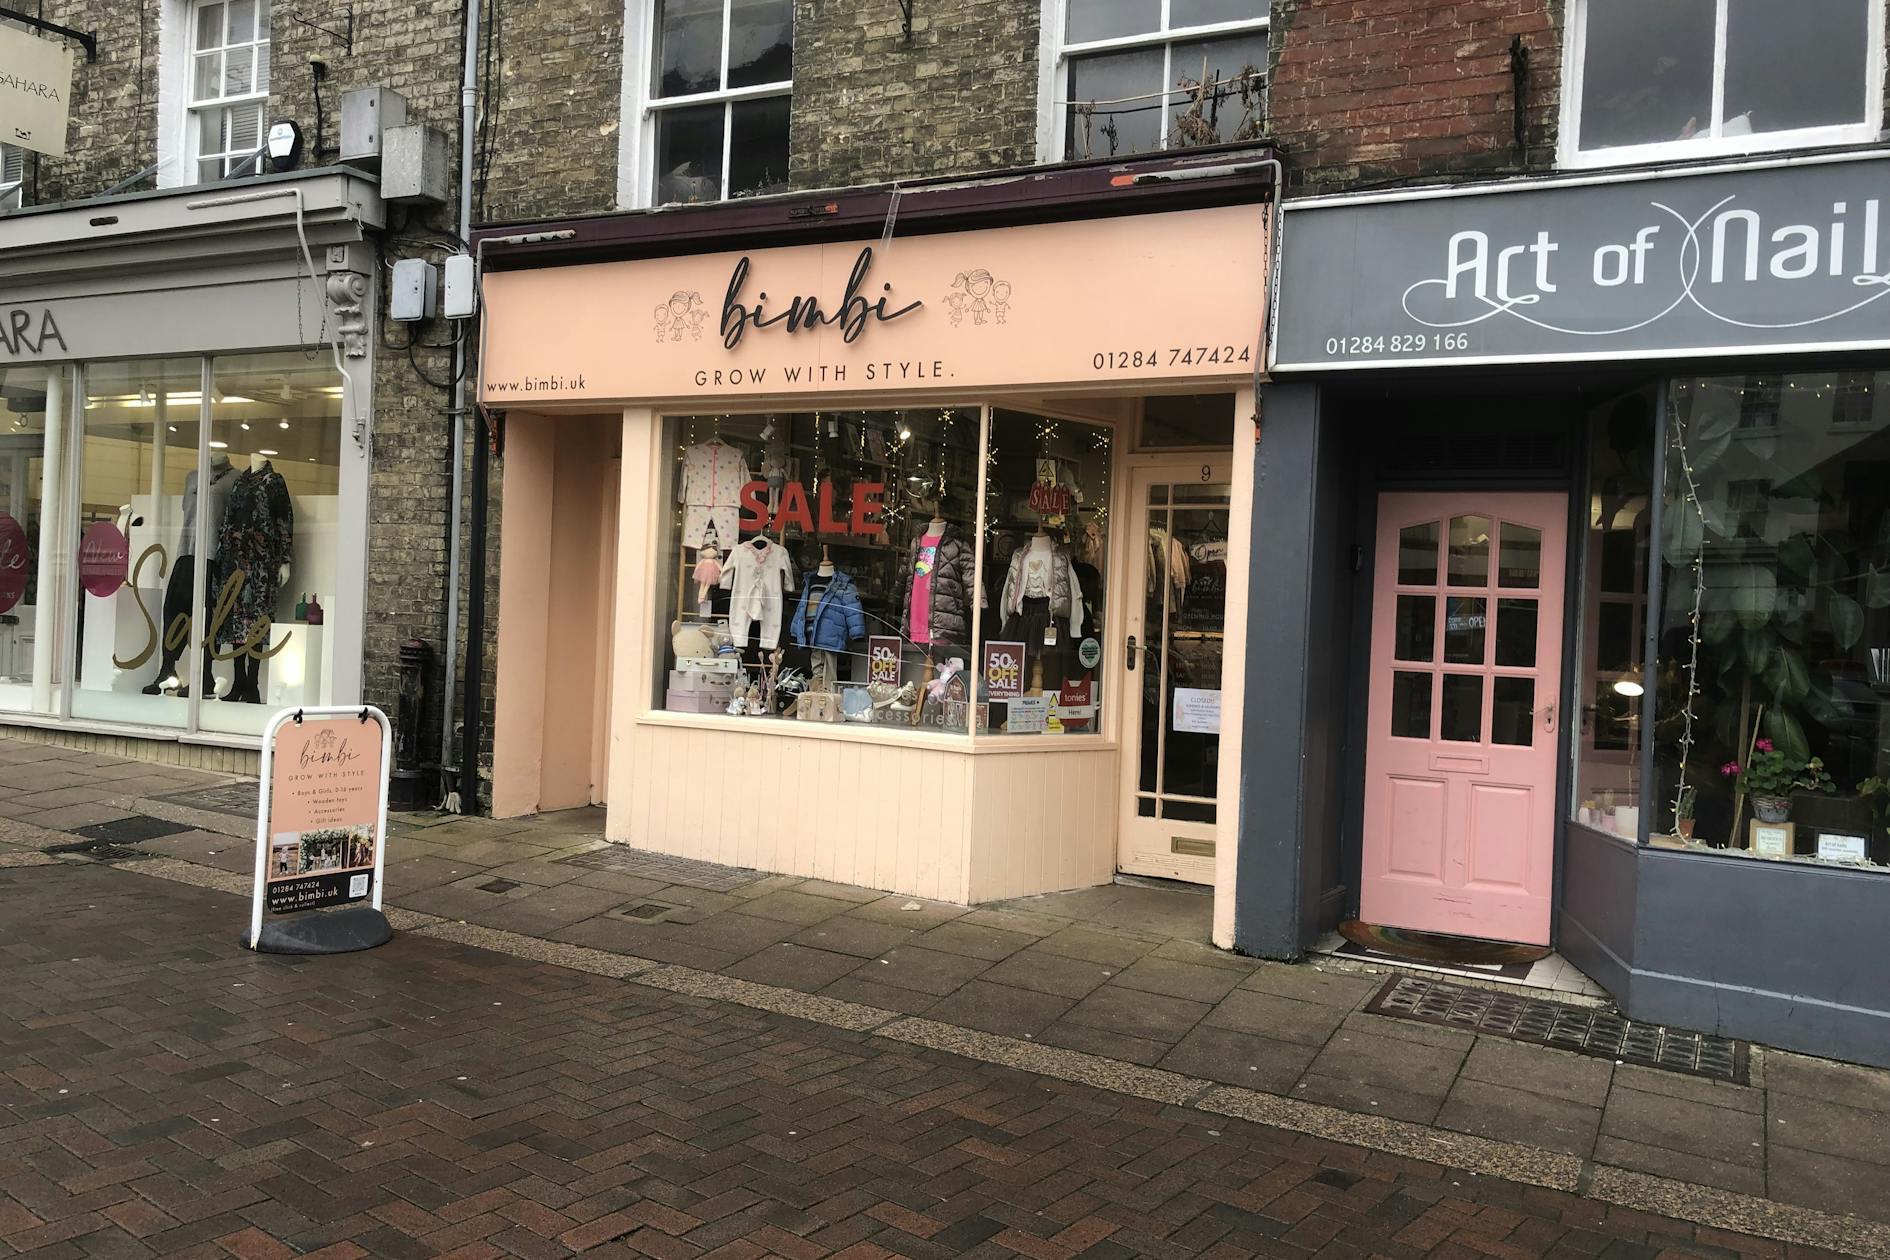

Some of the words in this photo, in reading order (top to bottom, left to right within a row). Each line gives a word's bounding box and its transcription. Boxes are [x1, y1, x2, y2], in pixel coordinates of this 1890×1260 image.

[1445, 229, 1559, 302] Art
[1592, 224, 1661, 287] of
[1710, 199, 1890, 285] Nail
[720, 246, 924, 350] bimbi
[1325, 335, 1386, 356] 01284
[1390, 333, 1427, 353] 829
[1432, 332, 1469, 352] 166
[1093, 350, 1158, 370] 01284
[1168, 345, 1251, 367] 747424
[486, 373, 586, 392] www.bimbi.uk
[694, 367, 767, 387] GROW
[784, 365, 847, 383] WITH
[866, 360, 955, 380] STYLE.
[1201, 464, 1211, 482] 9
[739, 481, 885, 534] SALE
[1031, 488, 1070, 510] SALE
[112, 542, 293, 671] Sale
[872, 646, 897, 662] 50%
[989, 653, 1019, 670] 50%
[871, 660, 897, 673] OFF
[988, 668, 1018, 681] OFF
[871, 671, 896, 682] SALE
[988, 679, 1018, 689] SALE
[300, 738, 361, 769] bimbi
[288, 774, 313, 782] GROW
[318, 772, 338, 780] WITH
[313, 807, 345, 815] Accessories
[271, 886, 339, 905] www.bimbi.uk
[272, 885, 294, 894] 01284
[295, 881, 320, 891] 747424
